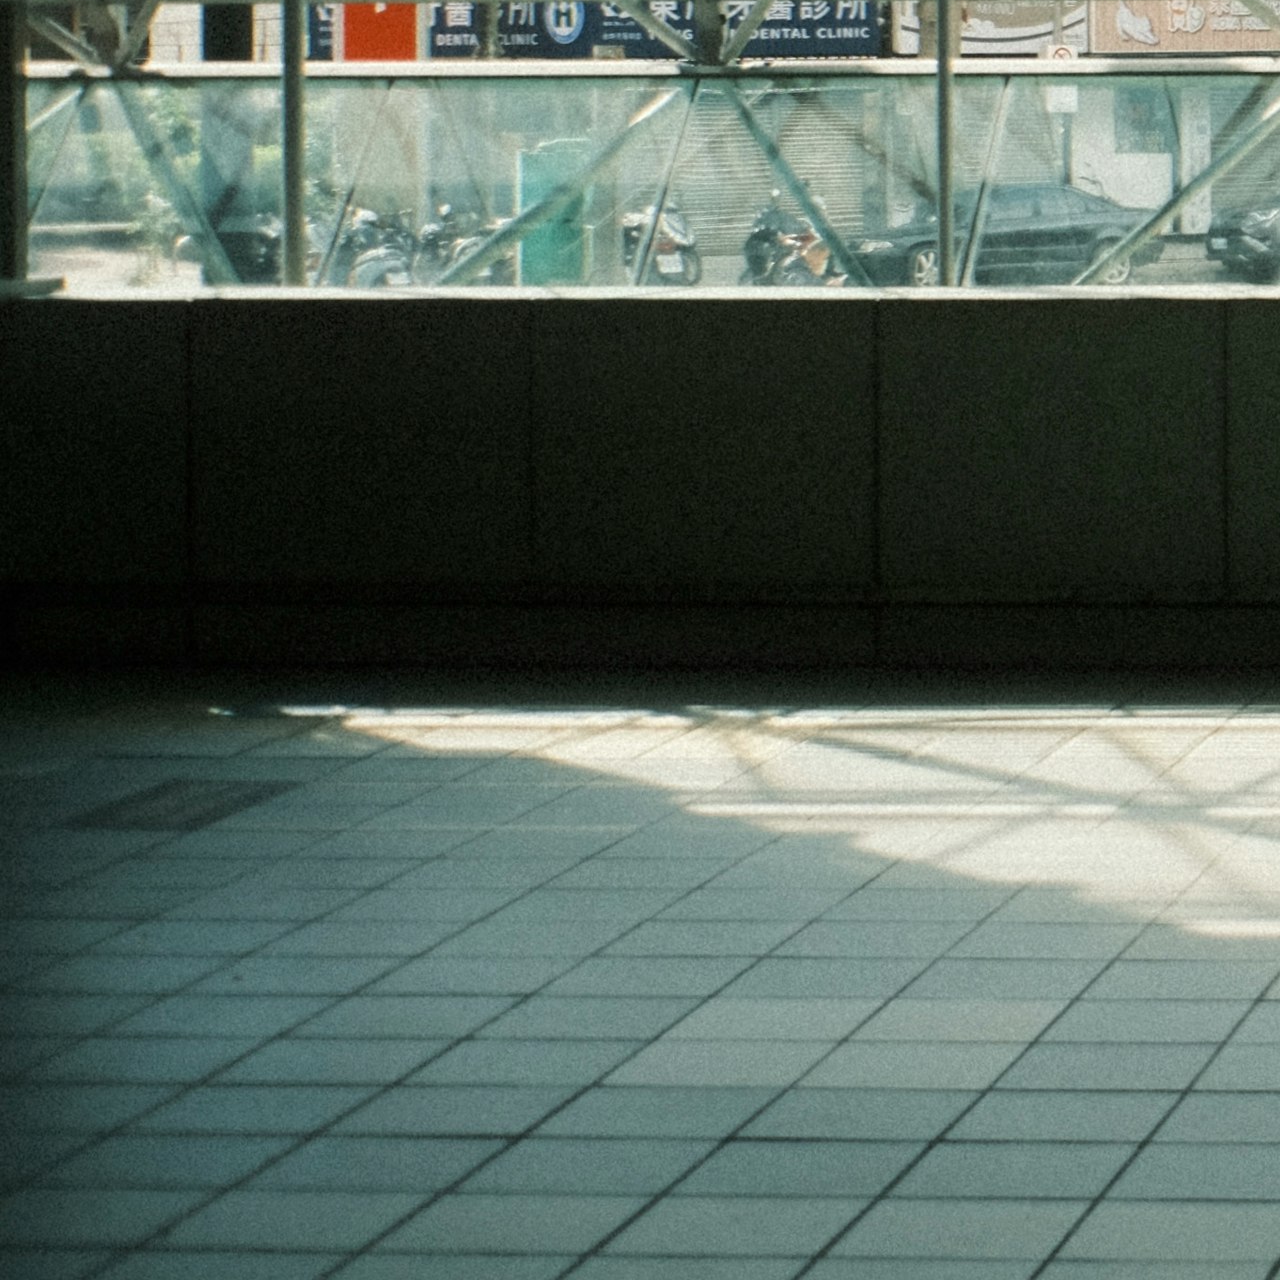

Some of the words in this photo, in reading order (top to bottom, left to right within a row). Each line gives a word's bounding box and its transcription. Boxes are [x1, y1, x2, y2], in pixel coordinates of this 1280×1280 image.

[651, 0, 867, 21] 東牙醫診所
[436, 34, 480, 46] DENTA
[749, 28, 811, 40] DENTAL
[816, 27, 871, 39] CLINIC
